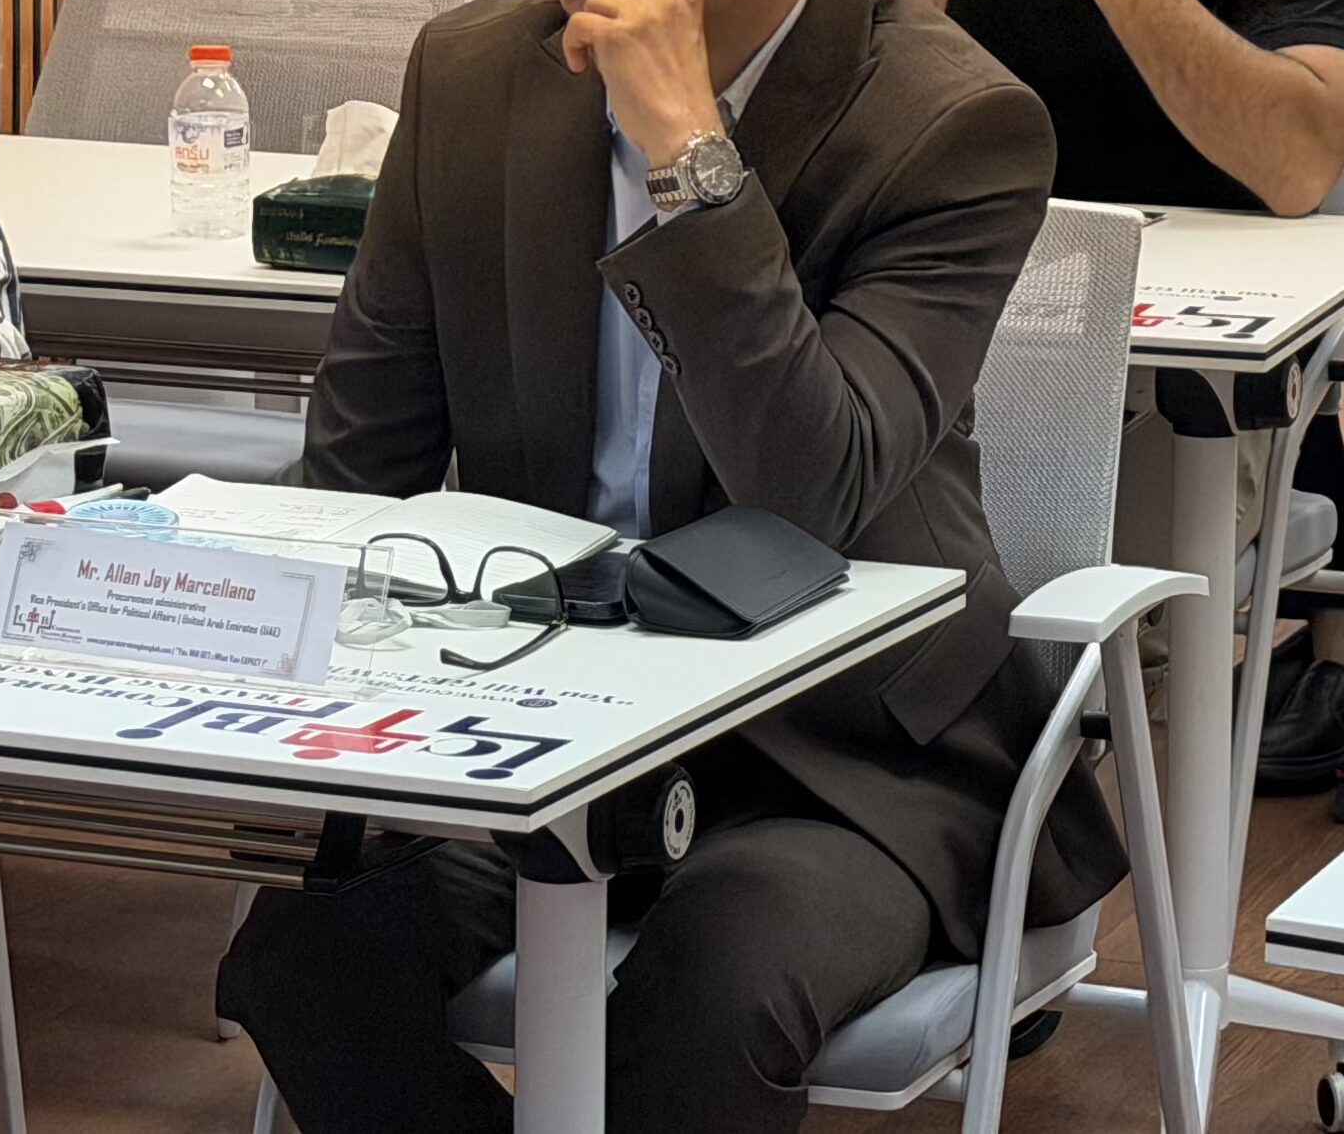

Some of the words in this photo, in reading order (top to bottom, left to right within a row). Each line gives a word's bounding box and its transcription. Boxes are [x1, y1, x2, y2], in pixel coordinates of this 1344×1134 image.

[77, 559, 100, 581] Mr.
[104, 562, 141, 586] Allan
[144, 568, 171, 593] Jay
[174, 572, 256, 601] Marcellano
